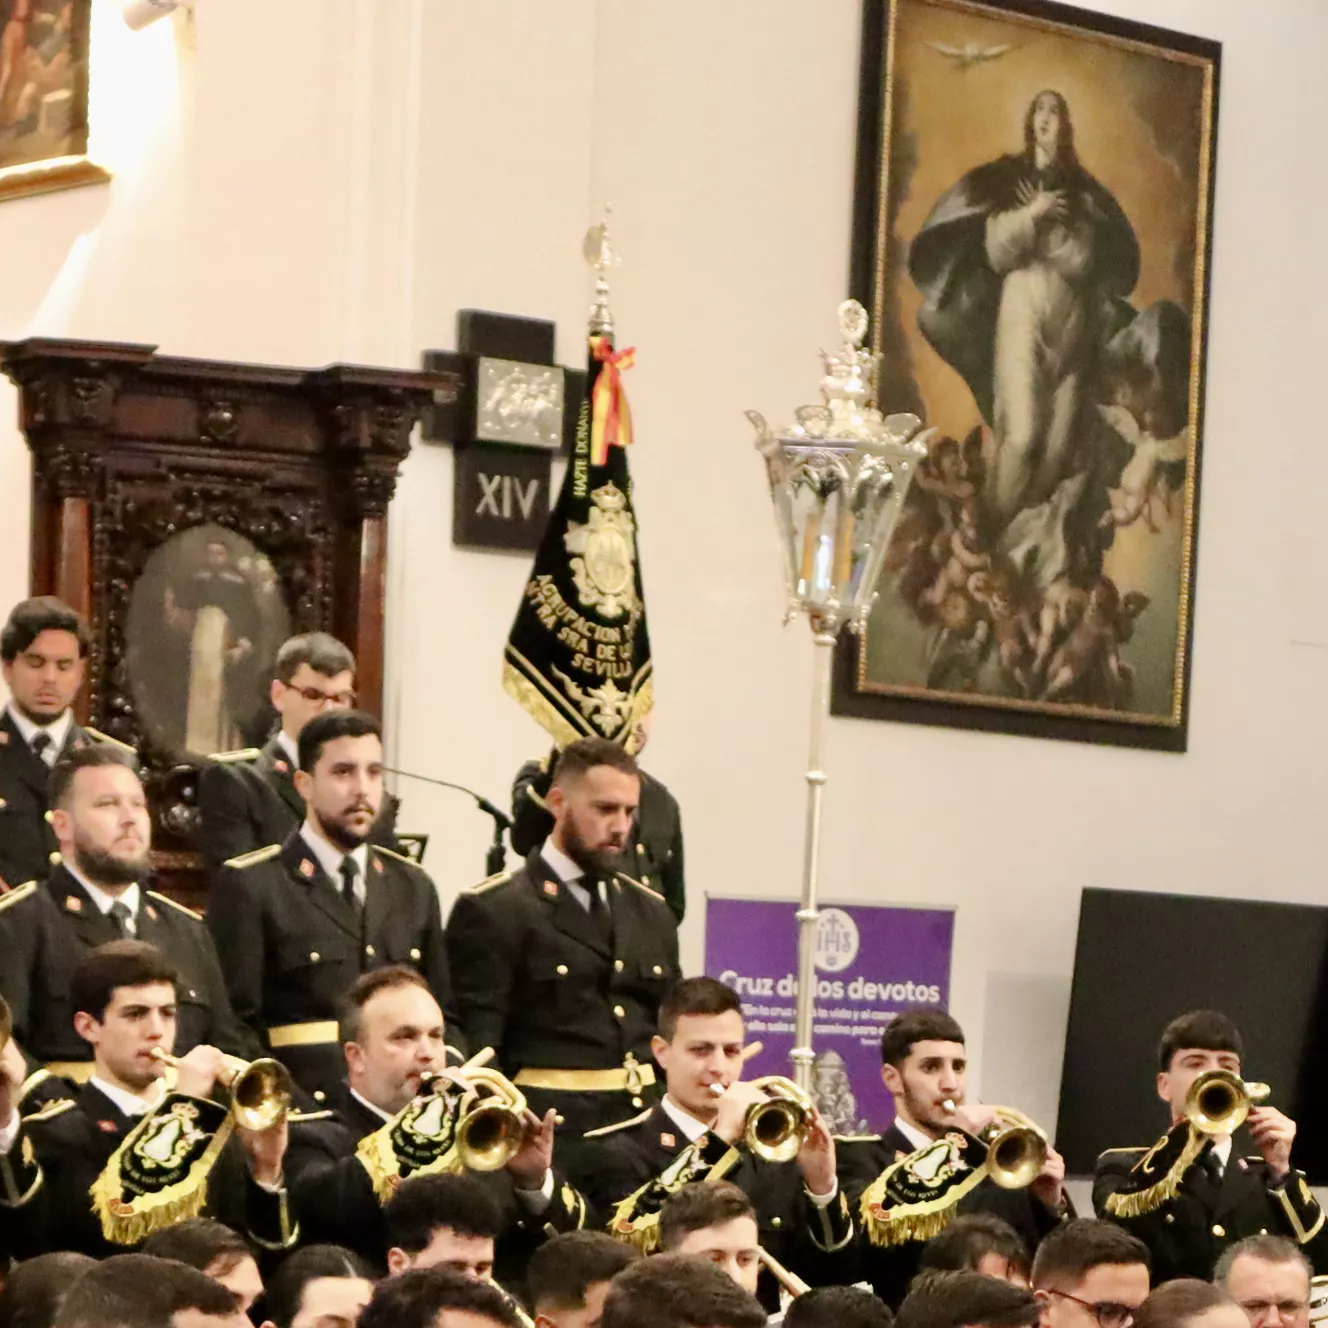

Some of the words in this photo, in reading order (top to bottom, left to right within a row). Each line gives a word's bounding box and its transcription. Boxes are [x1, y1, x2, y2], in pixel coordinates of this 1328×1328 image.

[476, 472, 539, 519] XIV
[596, 643, 617, 661] DE
[847, 976, 941, 1003] devotos
